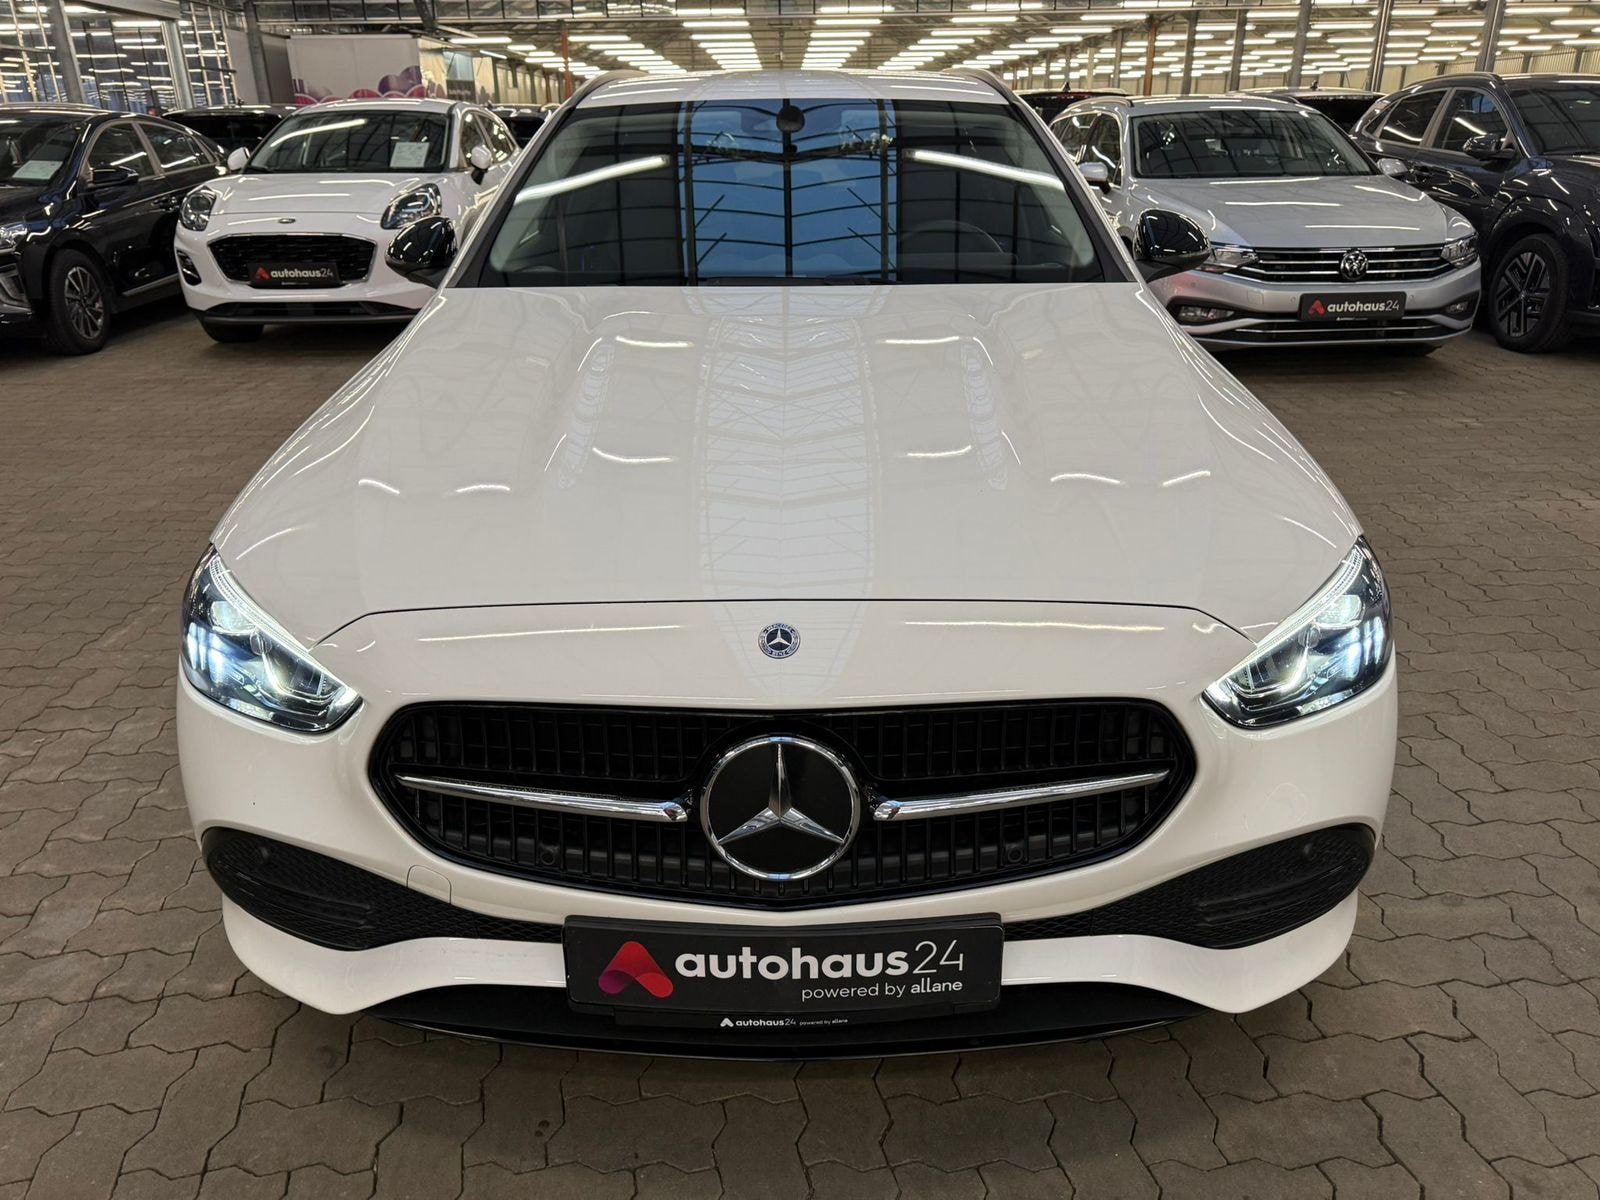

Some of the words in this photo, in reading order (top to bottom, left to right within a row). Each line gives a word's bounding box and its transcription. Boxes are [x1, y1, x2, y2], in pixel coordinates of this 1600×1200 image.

[270, 267, 333, 278] autohaus24
[1327, 300, 1399, 312] autohaus24
[675, 940, 964, 980] autohaus24
[802, 983, 879, 1002] powered
[885, 981, 906, 998] by
[910, 977, 963, 994] allane
[735, 1018, 796, 1027] autohaus24
